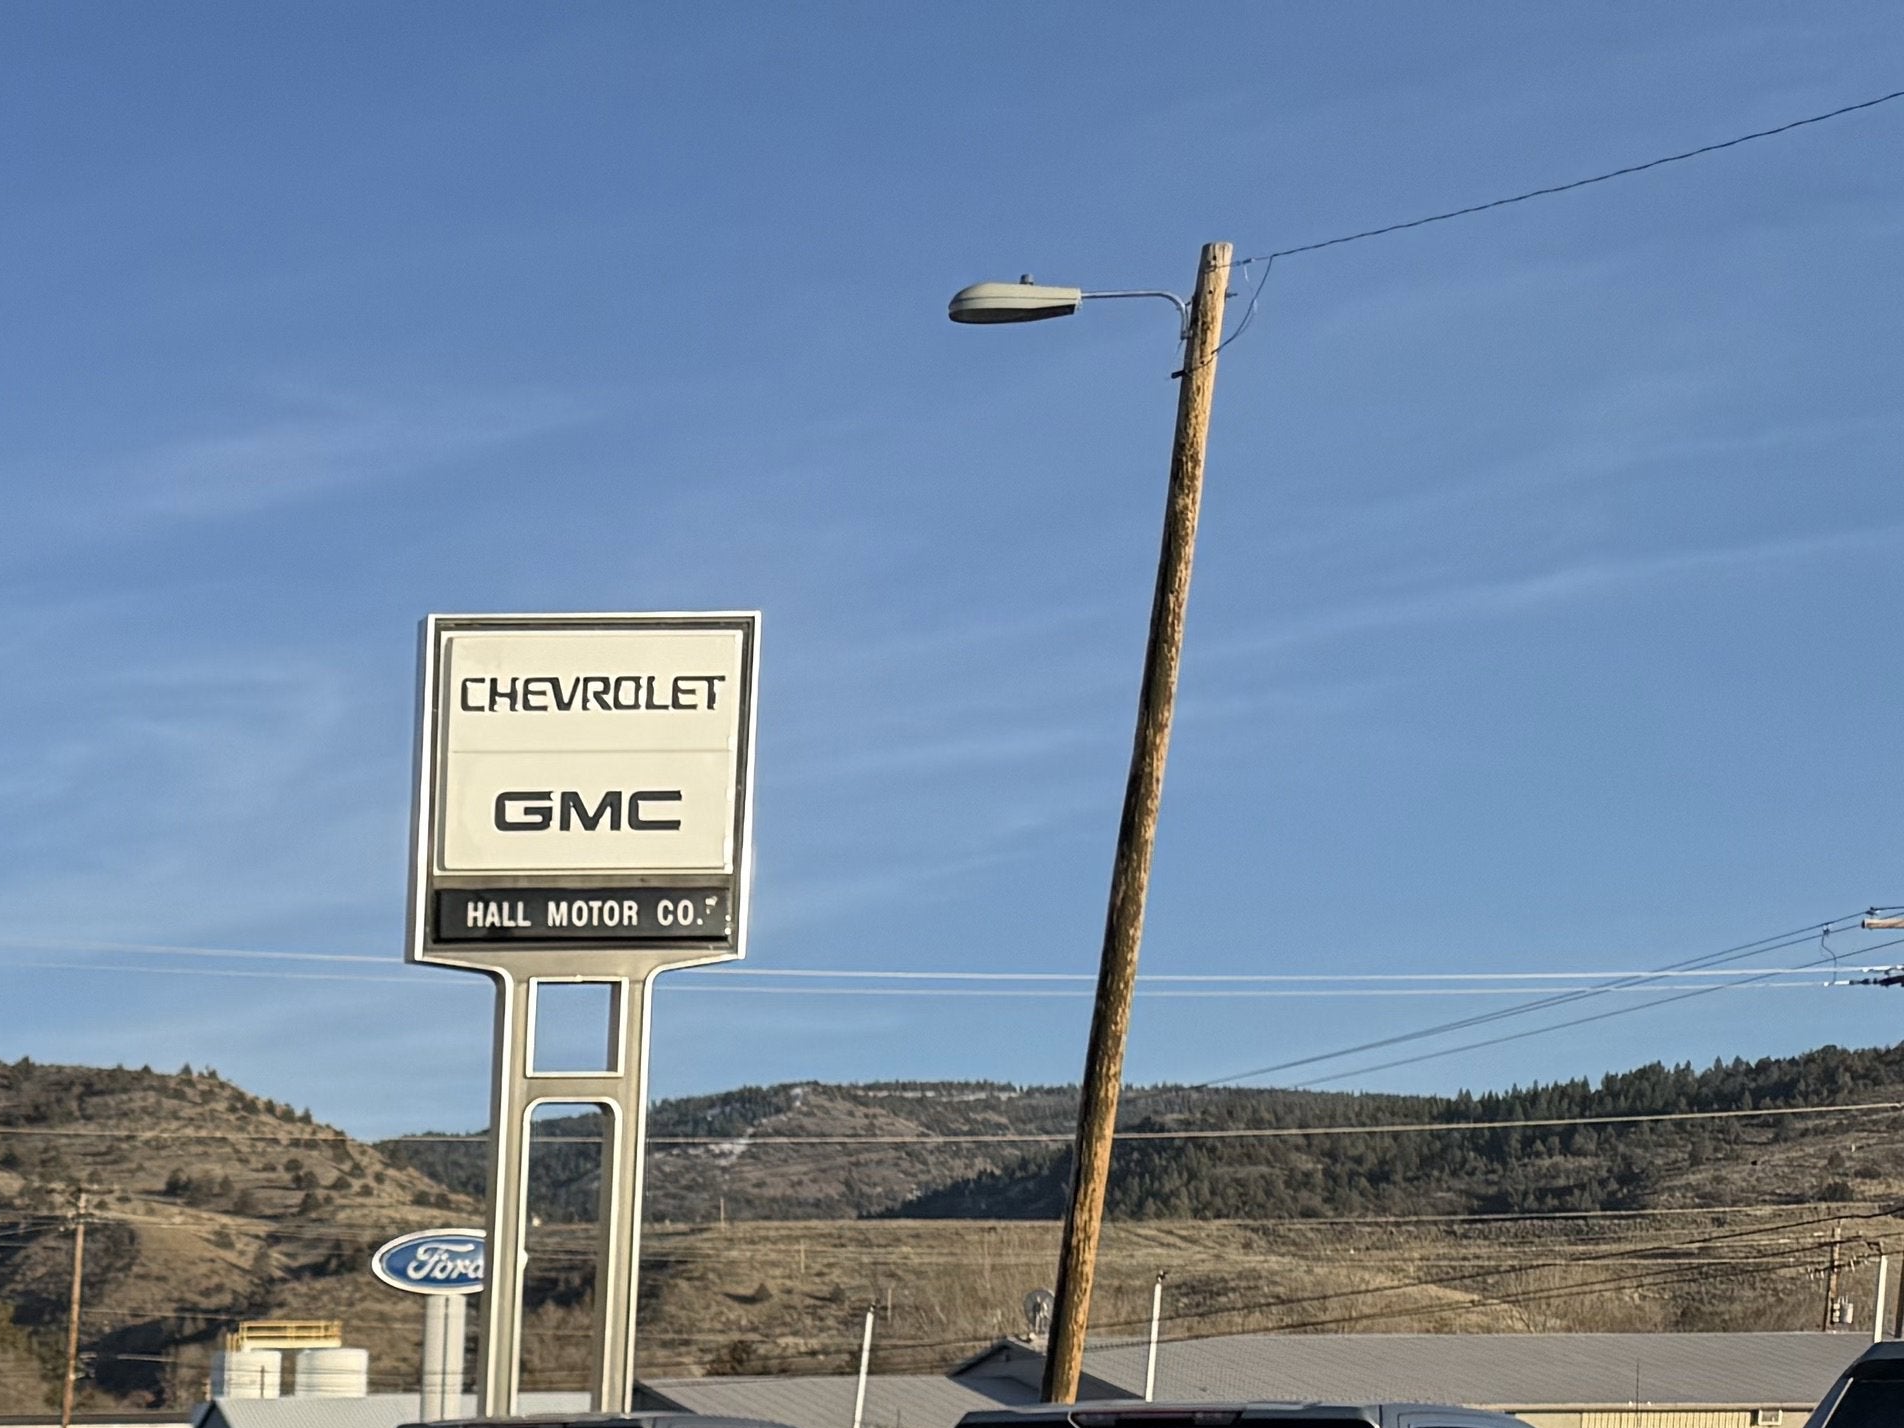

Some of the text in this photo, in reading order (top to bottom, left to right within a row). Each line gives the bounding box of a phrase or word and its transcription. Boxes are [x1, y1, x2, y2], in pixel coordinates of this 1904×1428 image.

[460, 675, 726, 712] CHEVROLET
[494, 789, 682, 832] GMC
[466, 899, 704, 928] HALL MOTOR CO.
